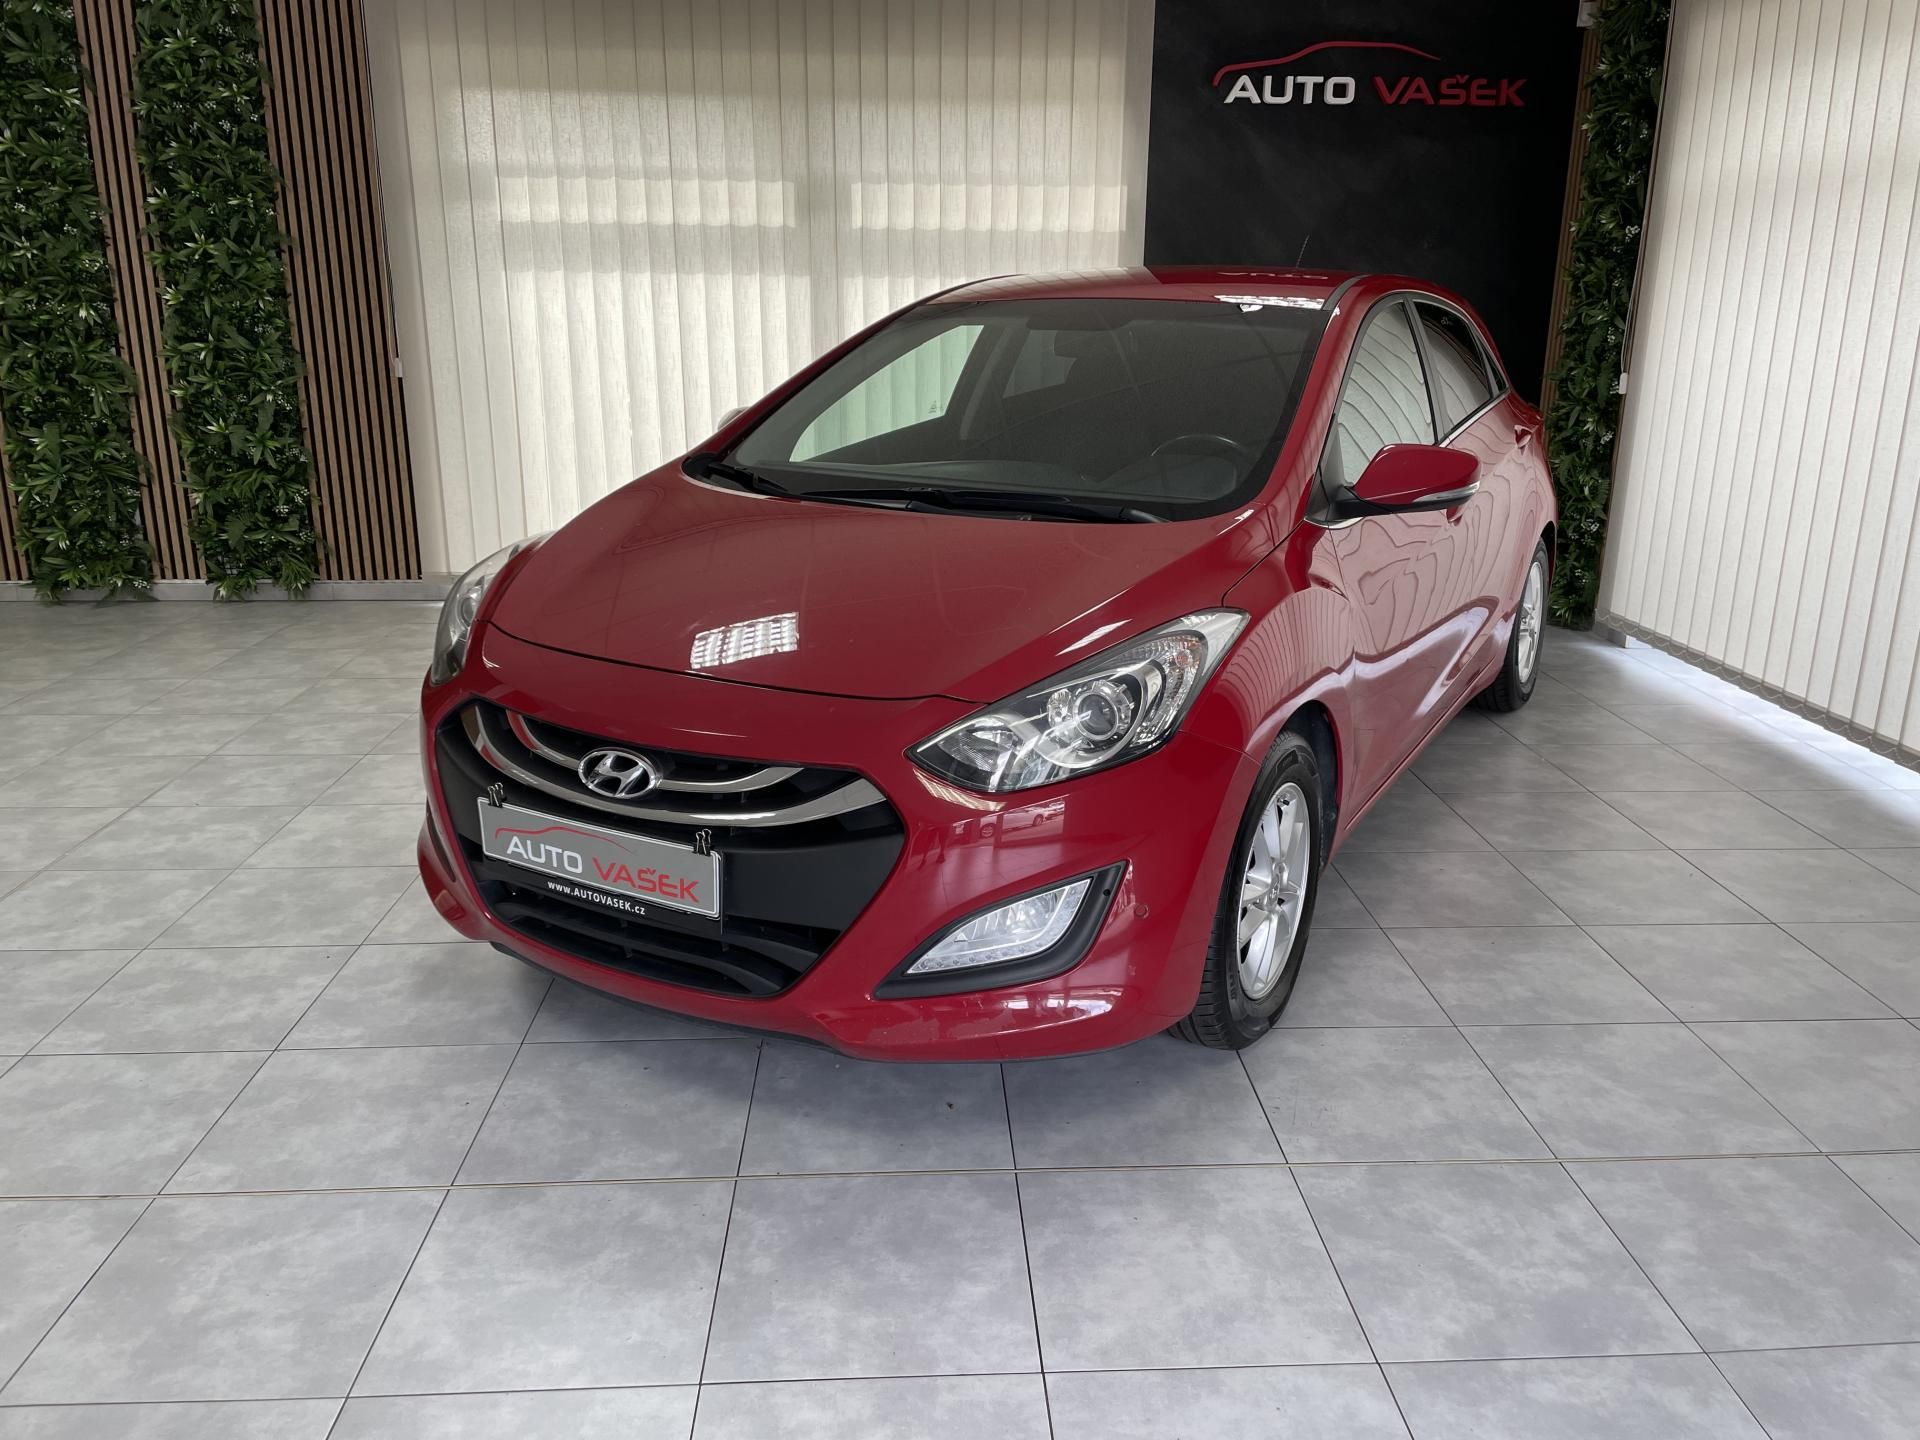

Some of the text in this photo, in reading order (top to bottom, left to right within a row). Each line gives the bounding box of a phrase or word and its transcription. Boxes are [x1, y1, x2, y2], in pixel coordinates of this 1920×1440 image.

[1223, 74, 1528, 107] AUTO VAŠEK
[506, 835, 699, 903] AUTO VAŠEK
[547, 880, 646, 916] www.AUTOVASEK.cz
